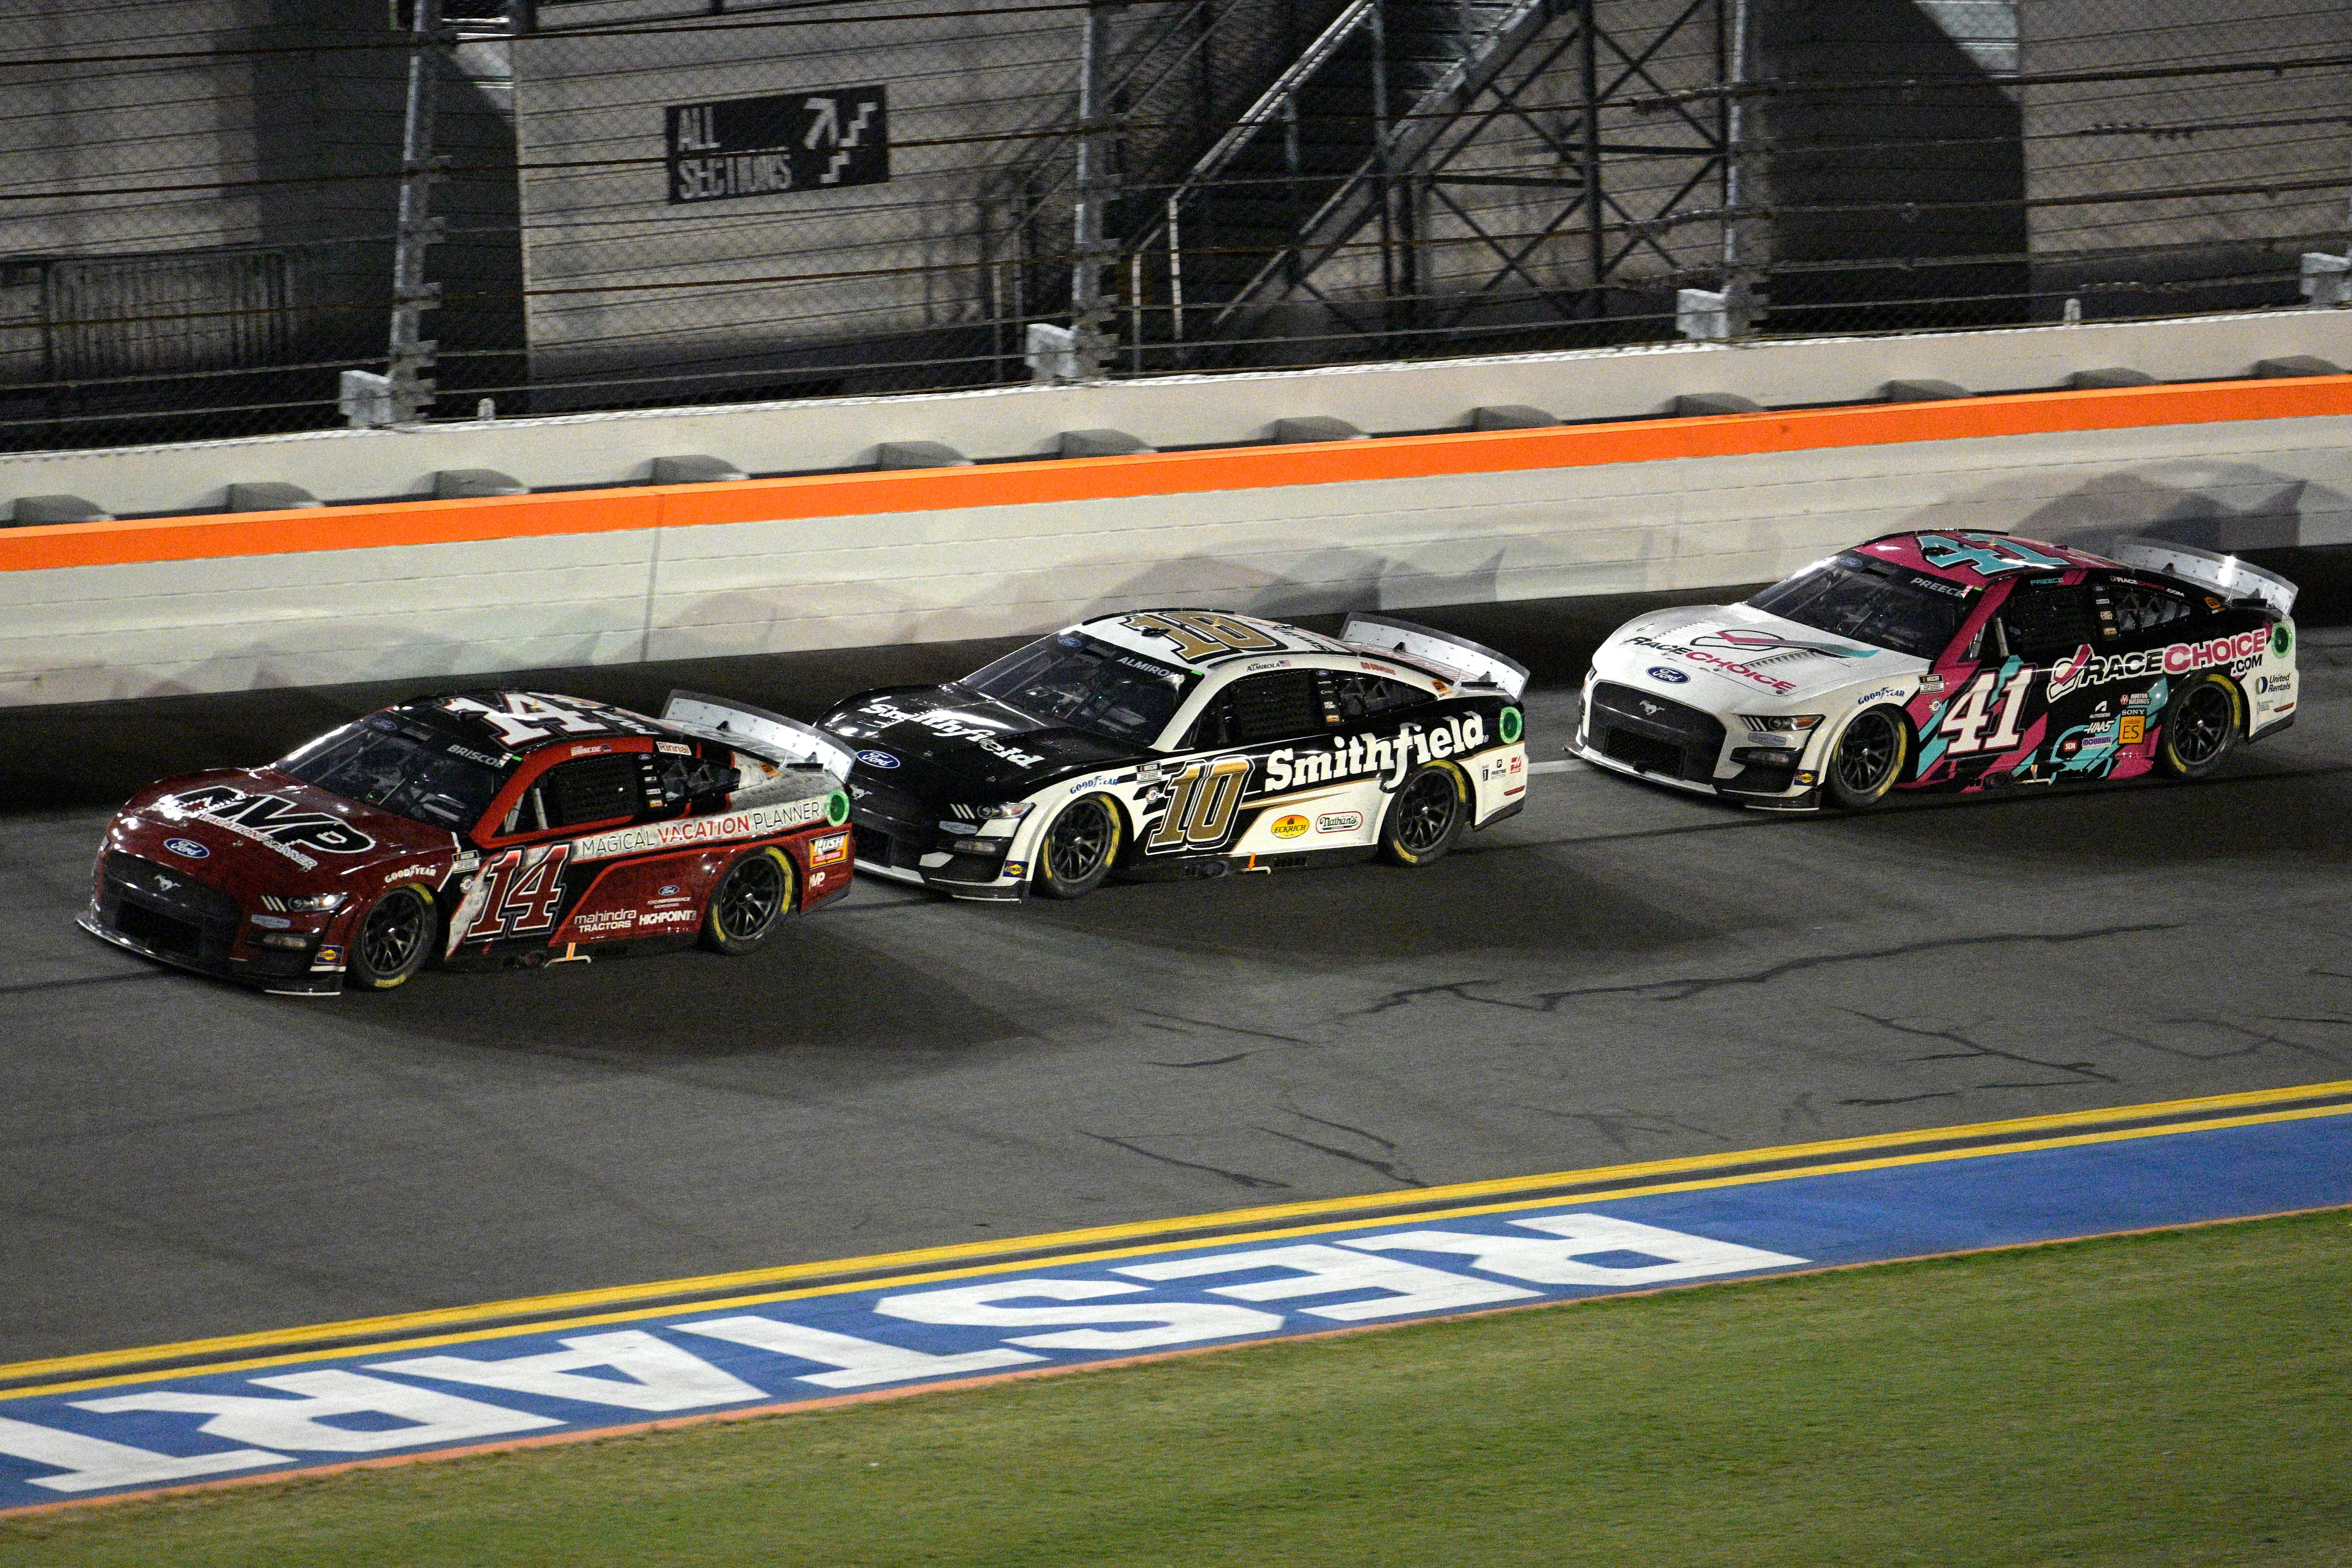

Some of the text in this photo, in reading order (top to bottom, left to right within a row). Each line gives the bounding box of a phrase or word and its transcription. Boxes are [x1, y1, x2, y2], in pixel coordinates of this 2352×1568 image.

[678, 106, 721, 151] ALL
[678, 146, 793, 200] SECTIONS
[1917, 533, 2071, 575] 41
[2030, 578, 2064, 586] PREECE
[1120, 611, 1284, 662] 10
[1116, 657, 1177, 679] ALMIRO
[1247, 663, 1280, 672] ALMIROLA
[2233, 654, 2263, 673] .COM
[1651, 668, 1682, 683] Ford
[2269, 672, 2290, 684] United
[1857, 687, 1905, 705] GOODYEAR
[2268, 682, 2291, 693] Rentals
[1940, 667, 2034, 755] 41
[2084, 720, 2116, 734] HAAS
[2123, 725, 2139, 739] ES
[659, 742, 690, 754] Rinnai
[1265, 711, 1484, 792] Smithfield
[861, 751, 895, 767] Ford
[1147, 759, 1251, 849] 10
[582, 801, 820, 857] MAGICAL VACATION PLANNER
[1274, 825, 1306, 833] ECKRICH
[1319, 815, 1358, 827] Nathan's
[168, 839, 205, 857] Ford
[813, 835, 846, 855] RUSH
[384, 864, 436, 883] GOODYEAR
[466, 843, 571, 938] 14
[574, 908, 637, 924] mahindra
[639, 910, 692, 926] HIGHPOINT
[579, 920, 632, 933] TRACTORS
[0, 1212, 1814, 1493] RESTART
